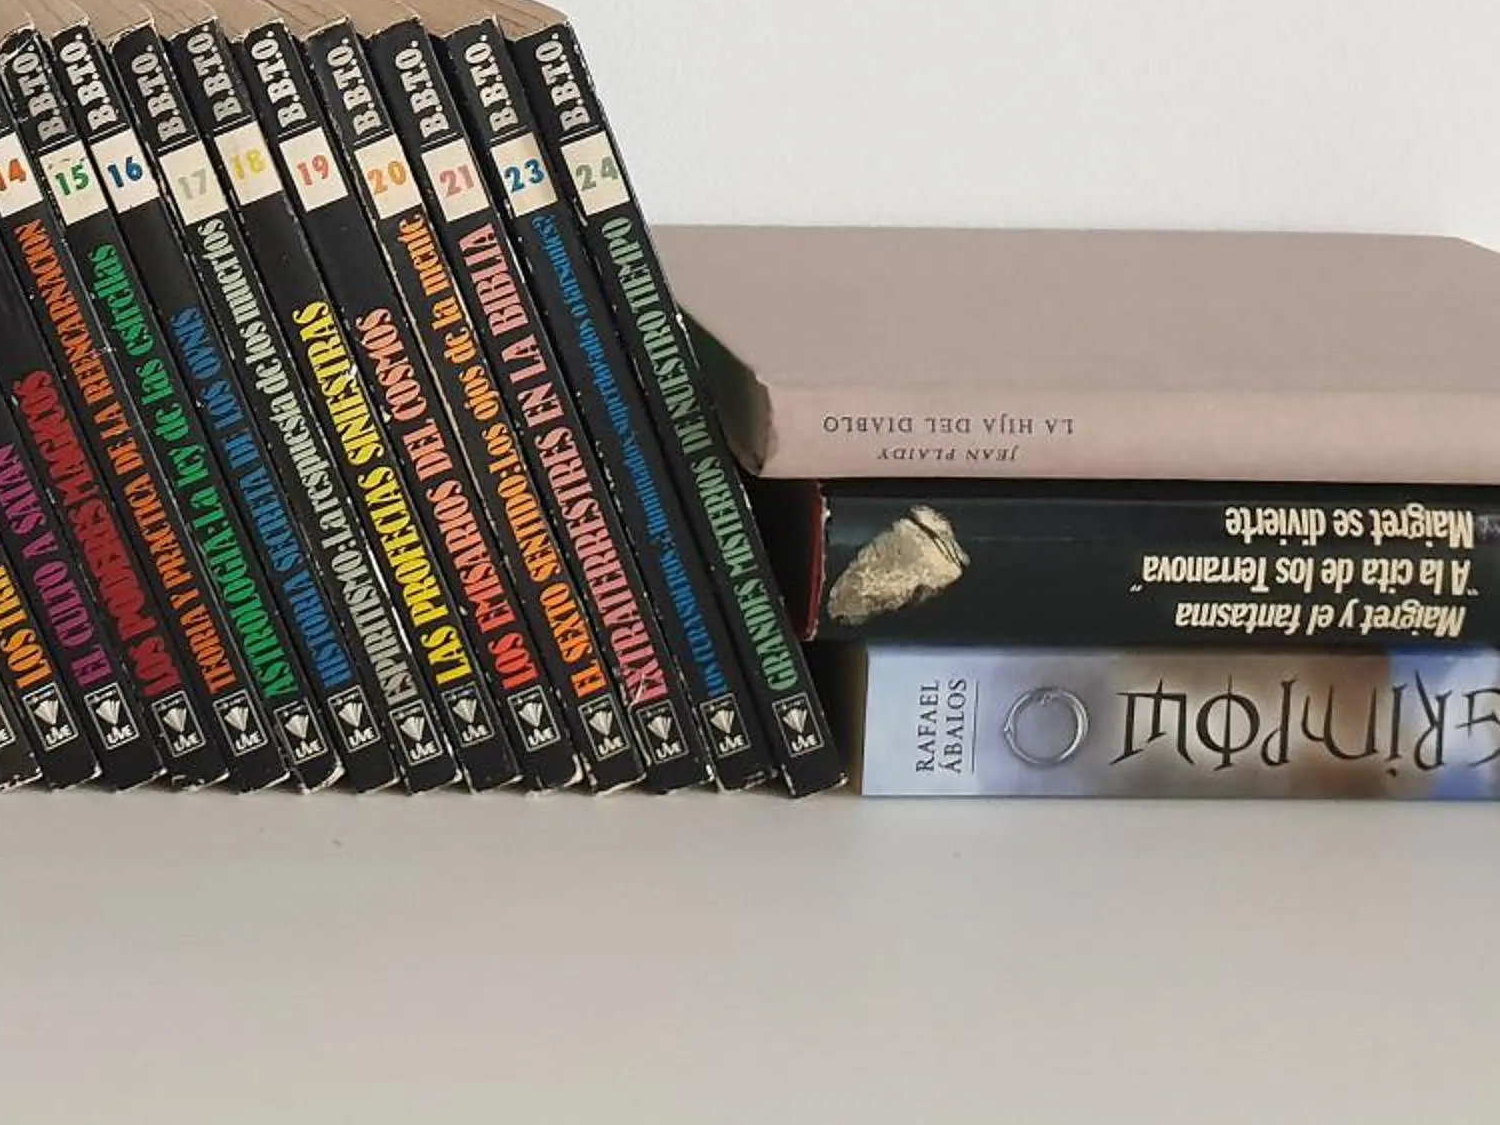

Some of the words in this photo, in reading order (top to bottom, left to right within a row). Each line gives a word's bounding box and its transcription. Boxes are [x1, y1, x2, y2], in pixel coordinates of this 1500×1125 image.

[5, 44, 67, 141] B.B.T.O.
[187, 25, 242, 121] B.B.T.O.
[327, 38, 382, 135] B.B.T.O.
[395, 40, 449, 138] B.B.T.O.
[536, 33, 590, 131] B.B.T.O.
[55, 163, 89, 196] 15
[107, 156, 143, 188] 16
[177, 168, 206, 200] 17
[231, 150, 265, 180] 18
[297, 155, 329, 186] 19
[367, 161, 407, 195] 20
[439, 165, 474, 197] 21
[504, 159, 545, 193] 23
[575, 156, 618, 192] 24
[459, 223, 528, 336] BIBLIA
[601, 217, 660, 313] TIEMPO
[15, 219, 114, 404] REENCARNACION
[356, 309, 427, 421] COSMOS
[501, 334, 547, 383] LA
[636, 310, 695, 419] NUESTRO
[293, 302, 384, 465] SINIESTRAS
[517, 382, 564, 428] EN
[14, 371, 98, 505] MAGICOS
[94, 401, 131, 439] LA
[674, 415, 712, 454] DE
[822, 415, 914, 435] DIABLO
[924, 417, 971, 435] DEL
[983, 414, 1033, 435] HIJA
[1045, 417, 1074, 435] LA
[108, 437, 144, 475] DE
[403, 418, 453, 481] DEL
[877, 446, 957, 461] PLAIDY
[965, 444, 1020, 462] JEAN
[124, 473, 192, 589] PRACTICA
[691, 456, 757, 578] MISTERIOS
[1224, 506, 1326, 546] divierte
[1333, 508, 1364, 538] se
[1369, 501, 1475, 550] Maigret
[69, 499, 156, 640] PODERES
[358, 467, 449, 626] PROFECIAS
[426, 480, 515, 633] EMISARIOS
[535, 427, 667, 707] EXTRATERRESTRES
[1275, 556, 1315, 594] los
[1321, 557, 1353, 595] de
[1362, 557, 1414, 595] cita
[1419, 558, 1442, 596] la
[170, 589, 199, 609] Y
[1174, 601, 1301, 637] fantasma
[1306, 603, 1336, 636] el
[1337, 598, 1360, 629] y
[1361, 597, 1467, 638] Maigret
[180, 604, 236, 693] TEORIA
[421, 626, 472, 684] LAS
[734, 578, 798, 690] GRANDES
[0, 629, 52, 688] LOS
[129, 636, 181, 696] LOS
[488, 633, 538, 689] LOS
[915, 679, 942, 773] RAFAEL
[938, 678, 969, 774] ÁBALOS
